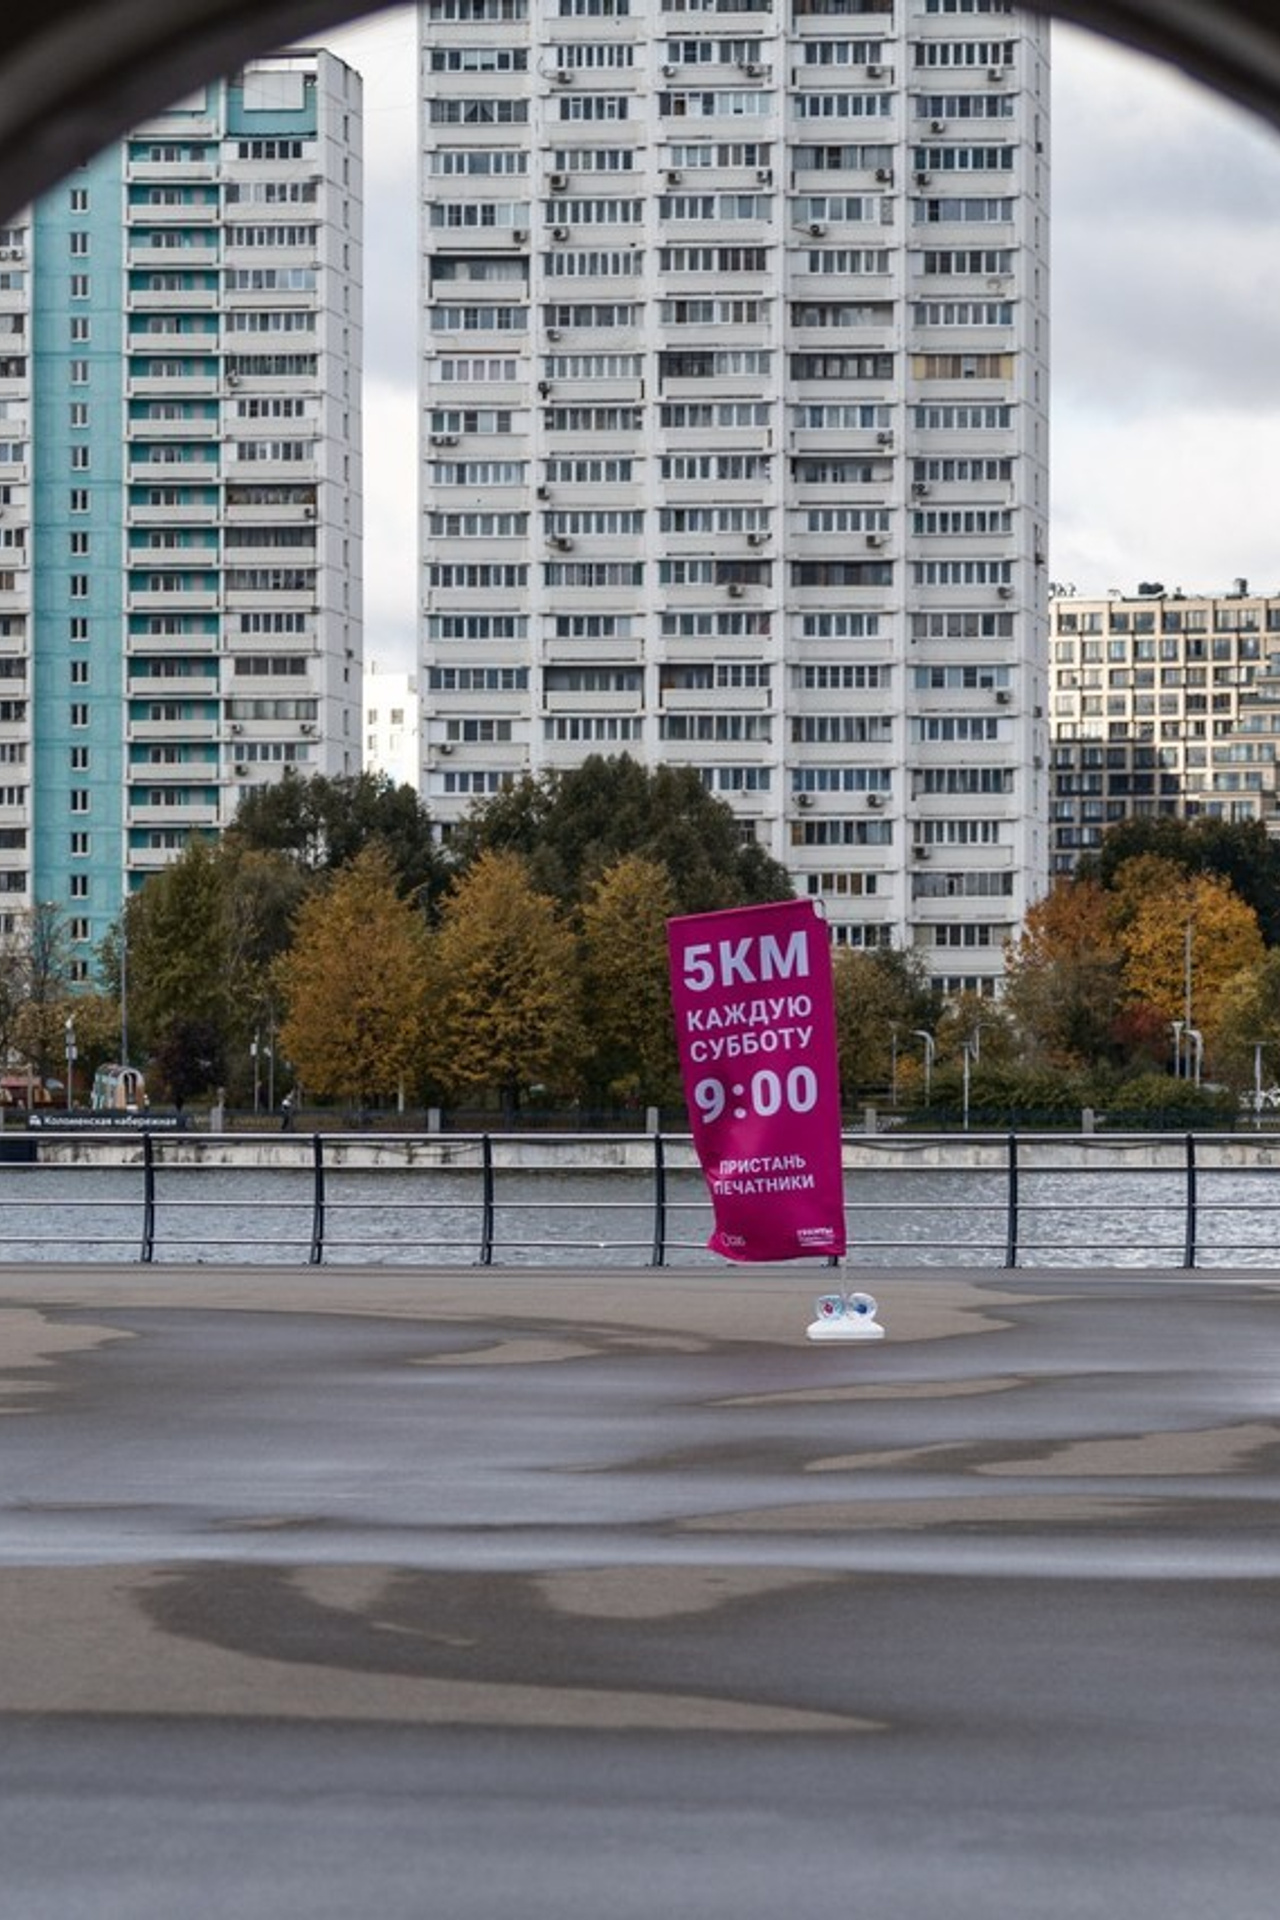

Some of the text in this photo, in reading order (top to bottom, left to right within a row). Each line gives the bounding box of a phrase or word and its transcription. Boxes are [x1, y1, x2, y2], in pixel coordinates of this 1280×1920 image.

[683, 931, 810, 991] 5КМ
[686, 995, 813, 1032] КАЖДУЮ
[690, 1026, 813, 1062] СУББОТУ
[694, 1066, 818, 1123] 9:00
[44, 1115, 112, 1126] Коломенская
[114, 1115, 177, 1128] набережная
[719, 1155, 806, 1175] ПРИСТАНЬ
[713, 1174, 815, 1196] ПЕЧАТНИКИ
